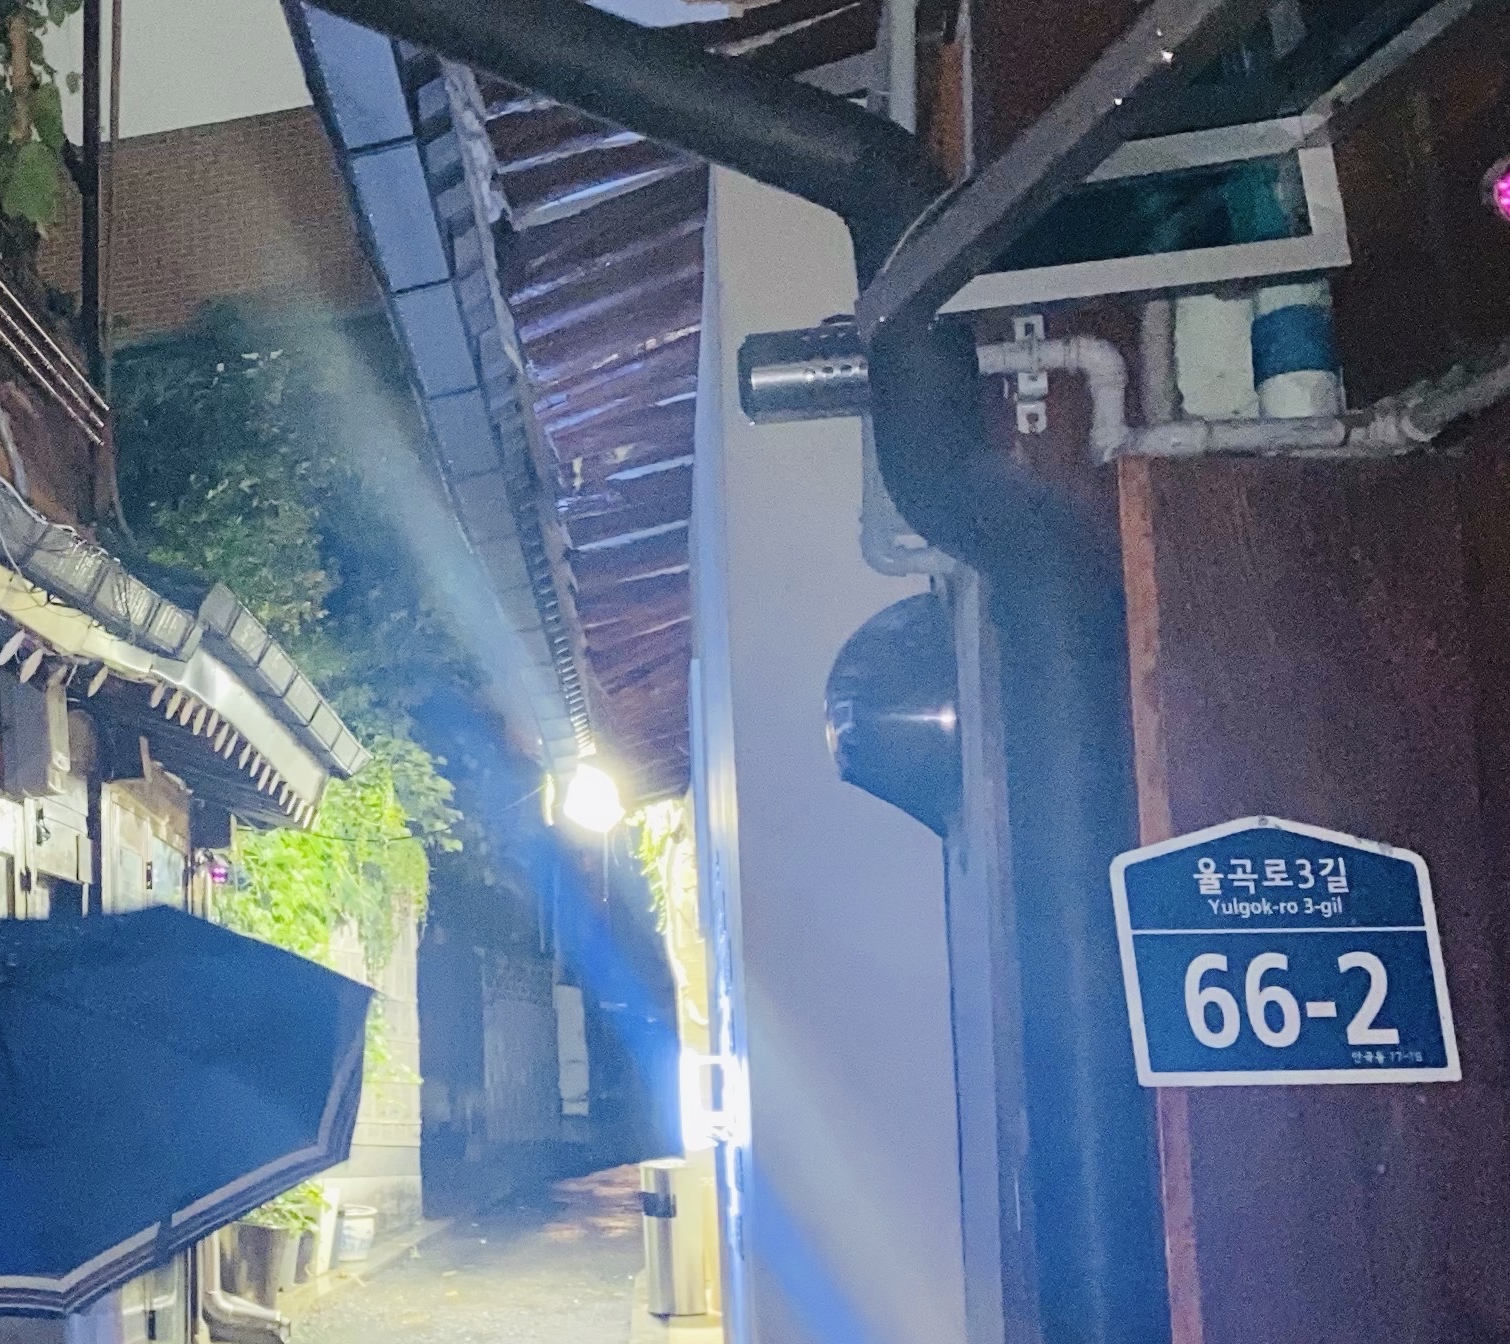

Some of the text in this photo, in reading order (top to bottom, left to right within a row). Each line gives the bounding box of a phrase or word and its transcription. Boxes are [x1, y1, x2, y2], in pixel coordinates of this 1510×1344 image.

[1193, 856, 1350, 896] 율곡로3길
[1207, 896, 1343, 918] Yulgok-ro 3-gil
[1184, 951, 1400, 1049] 66-2
